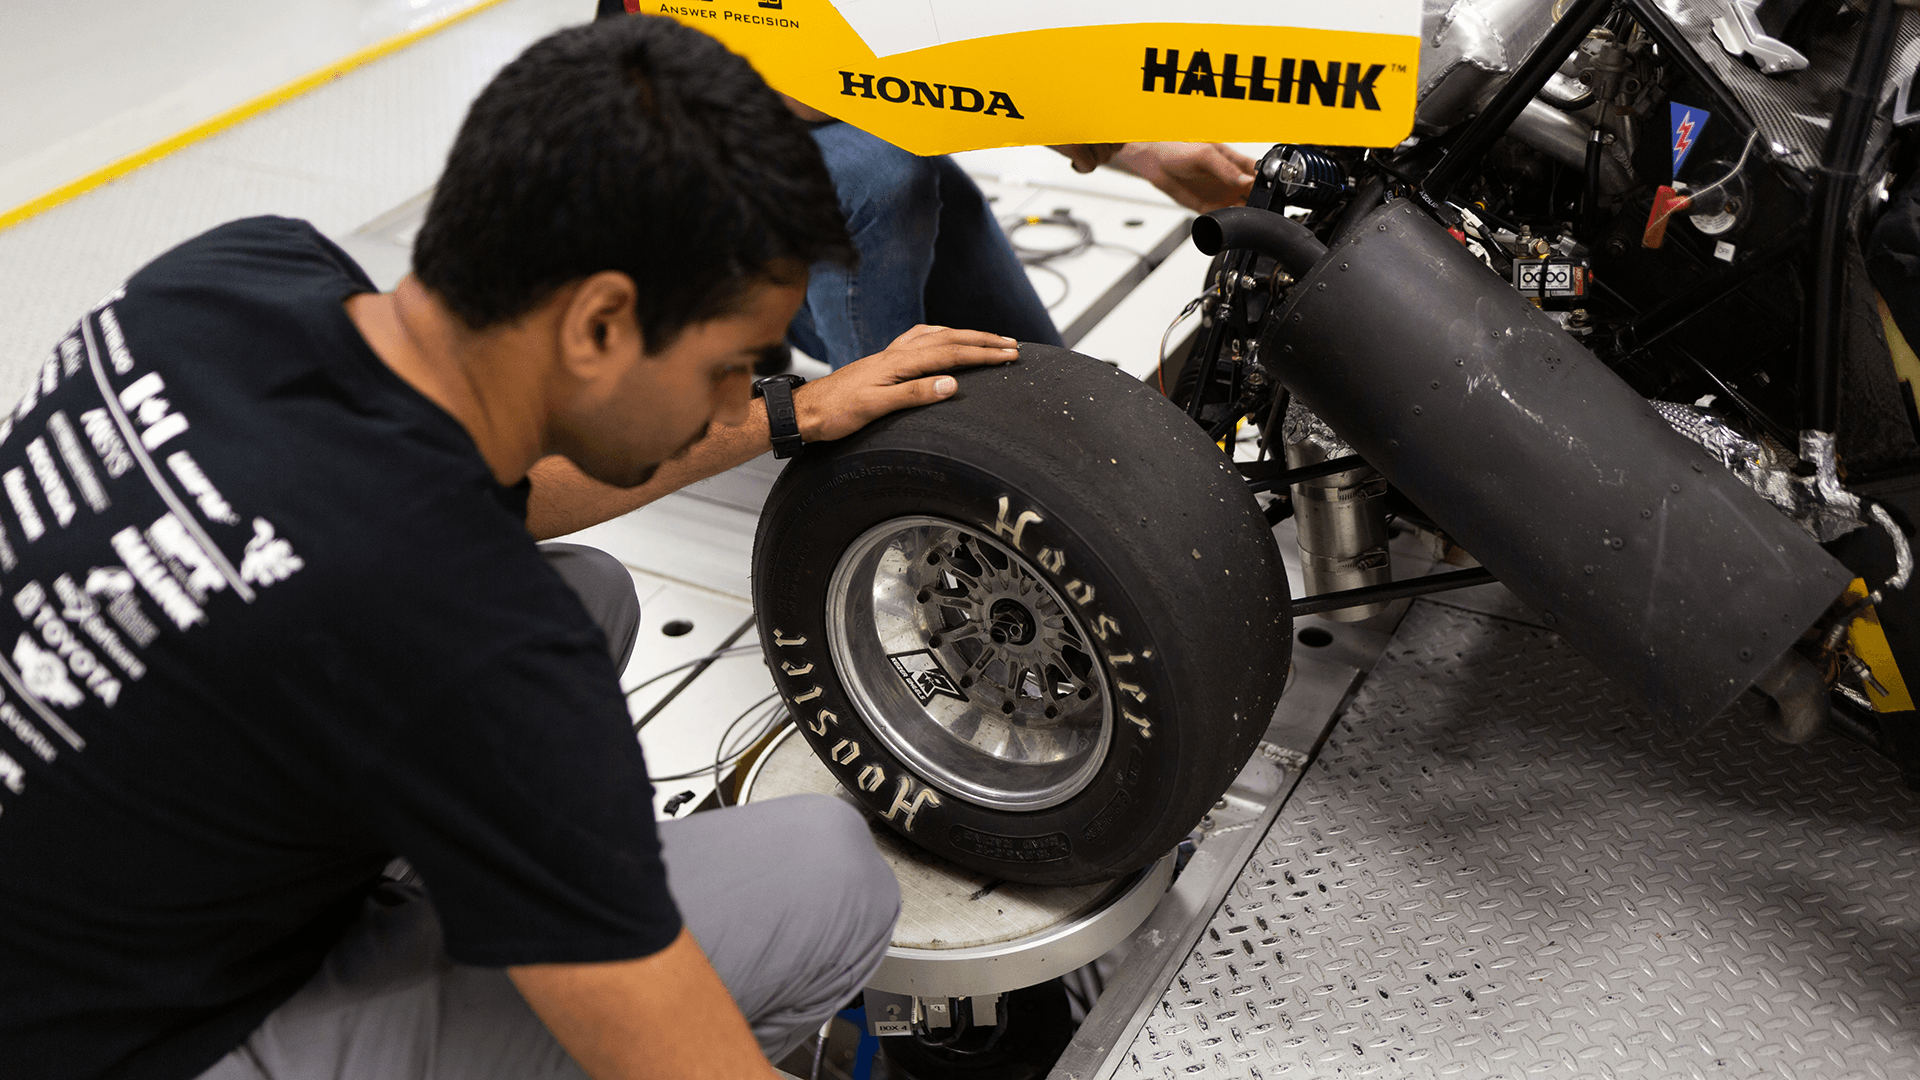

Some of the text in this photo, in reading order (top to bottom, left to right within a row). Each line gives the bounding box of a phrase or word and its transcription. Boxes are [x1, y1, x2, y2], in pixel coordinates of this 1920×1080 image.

[659, 3, 799, 29] ANSWER PRECISION
[838, 70, 1025, 120] HONDA
[1141, 47, 1387, 111] HALLINK
[1717, 246, 1731, 256] OFF
[80, 407, 135, 479] ANSYS
[857, 465, 894, 479] SAFETY
[981, 495, 1156, 739] Hoosier
[33, 602, 123, 709] TOYOTA
[770, 627, 940, 833] Hoosier
